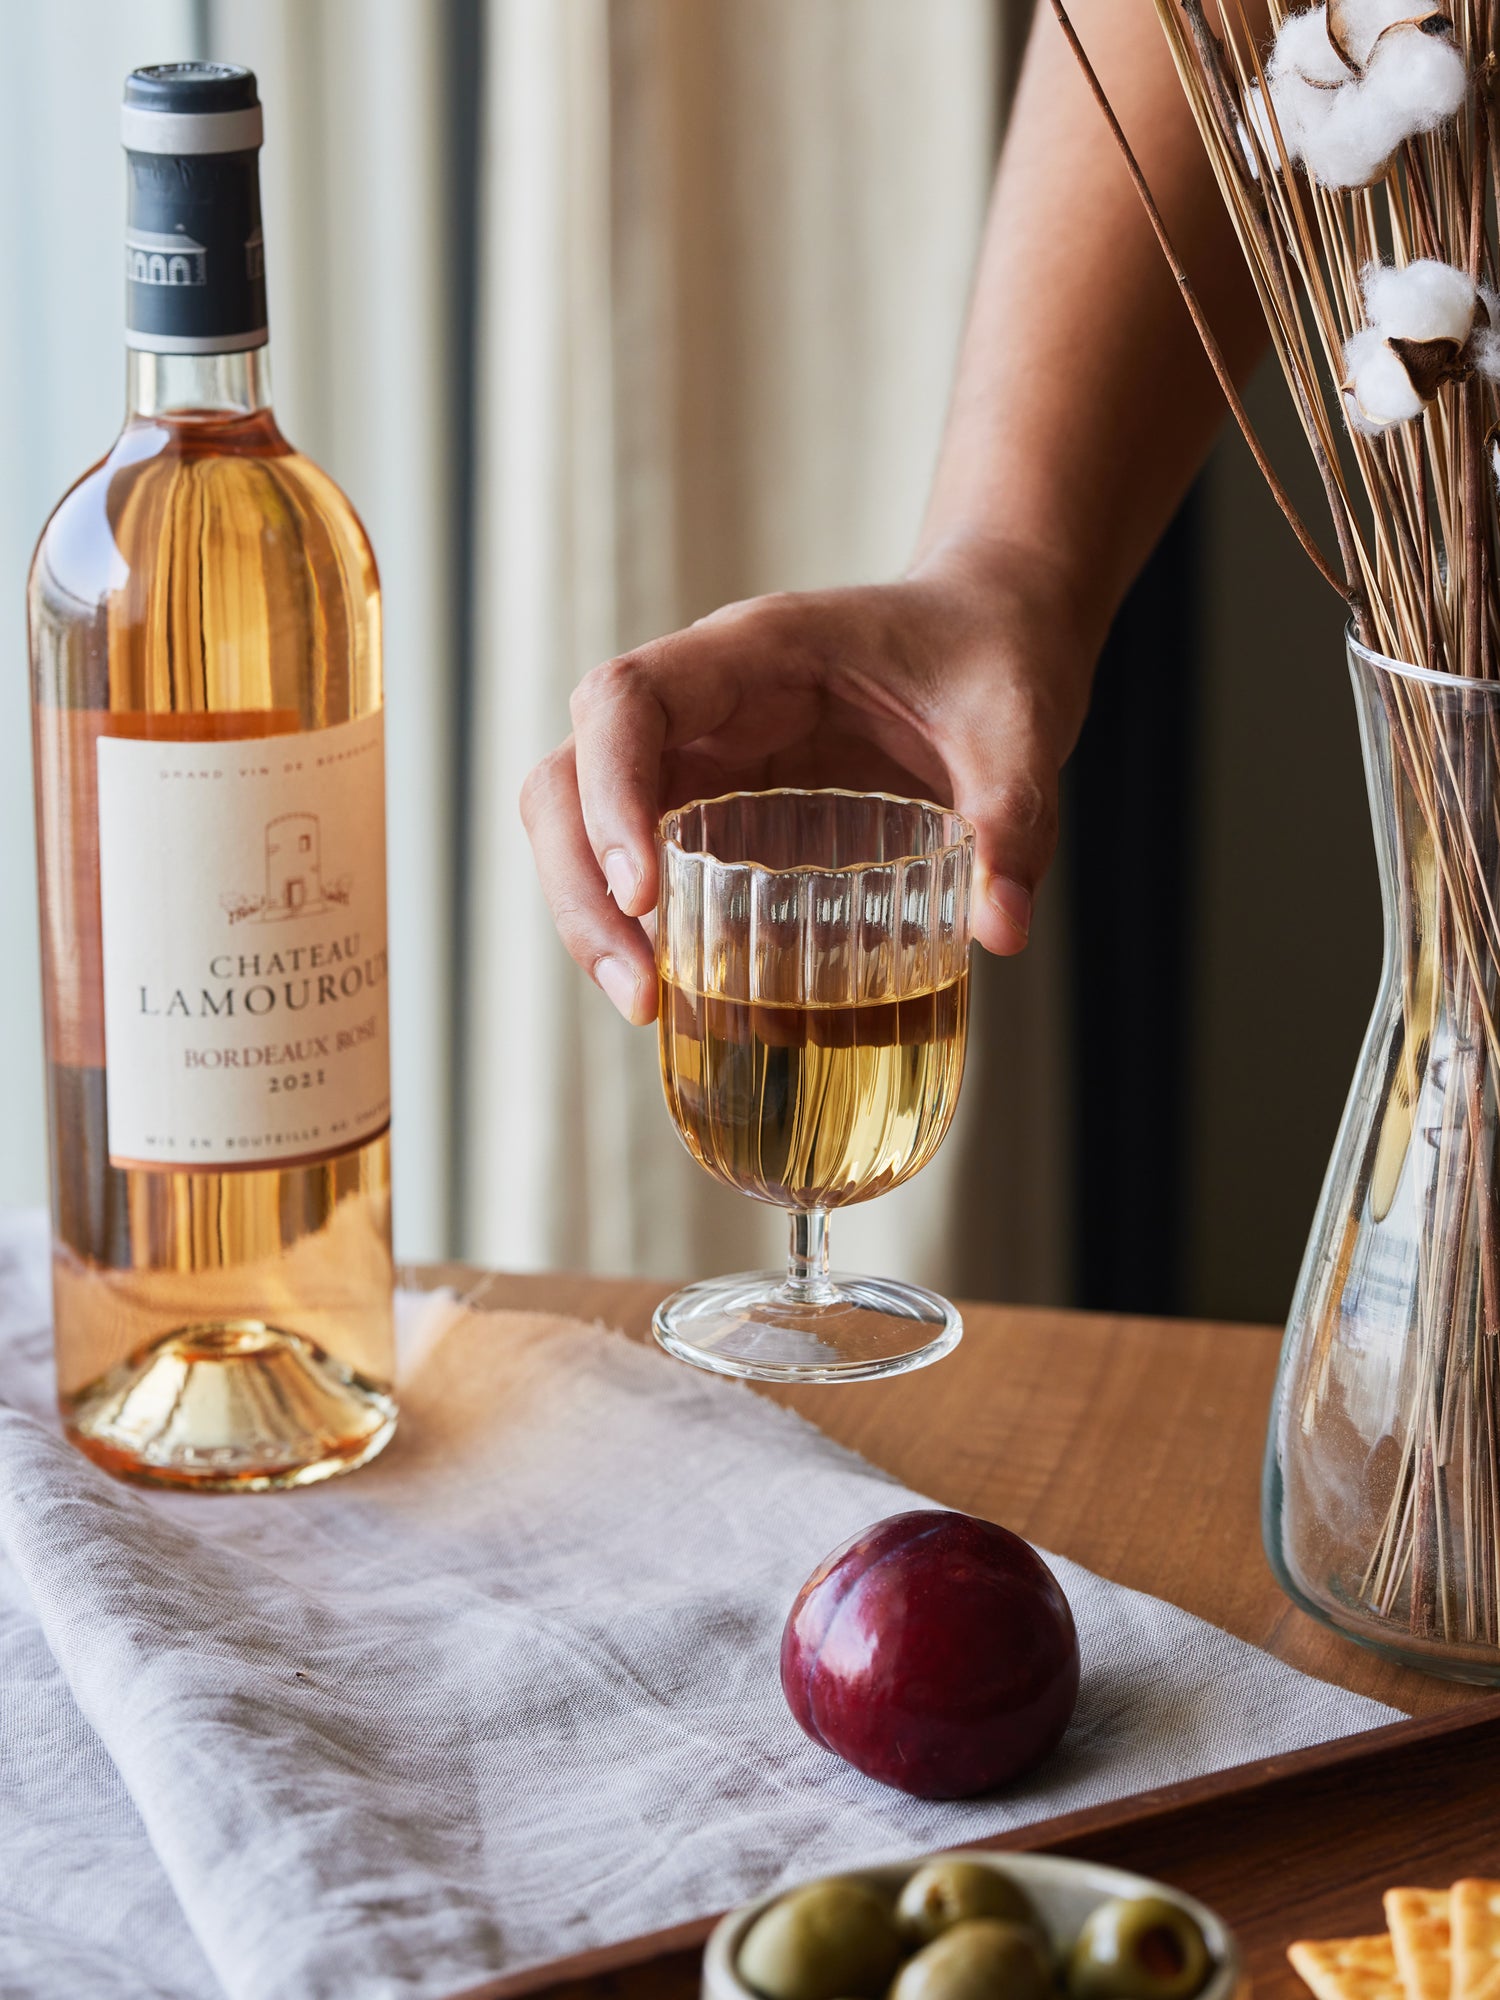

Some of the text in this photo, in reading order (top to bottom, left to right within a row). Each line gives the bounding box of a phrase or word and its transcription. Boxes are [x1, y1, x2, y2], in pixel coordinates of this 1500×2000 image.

[238, 767, 270, 777] VIN
[209, 932, 361, 979] CHATEAU
[184, 1033, 329, 1069] BORDEAUX
[268, 1069, 327, 1093] 2021
